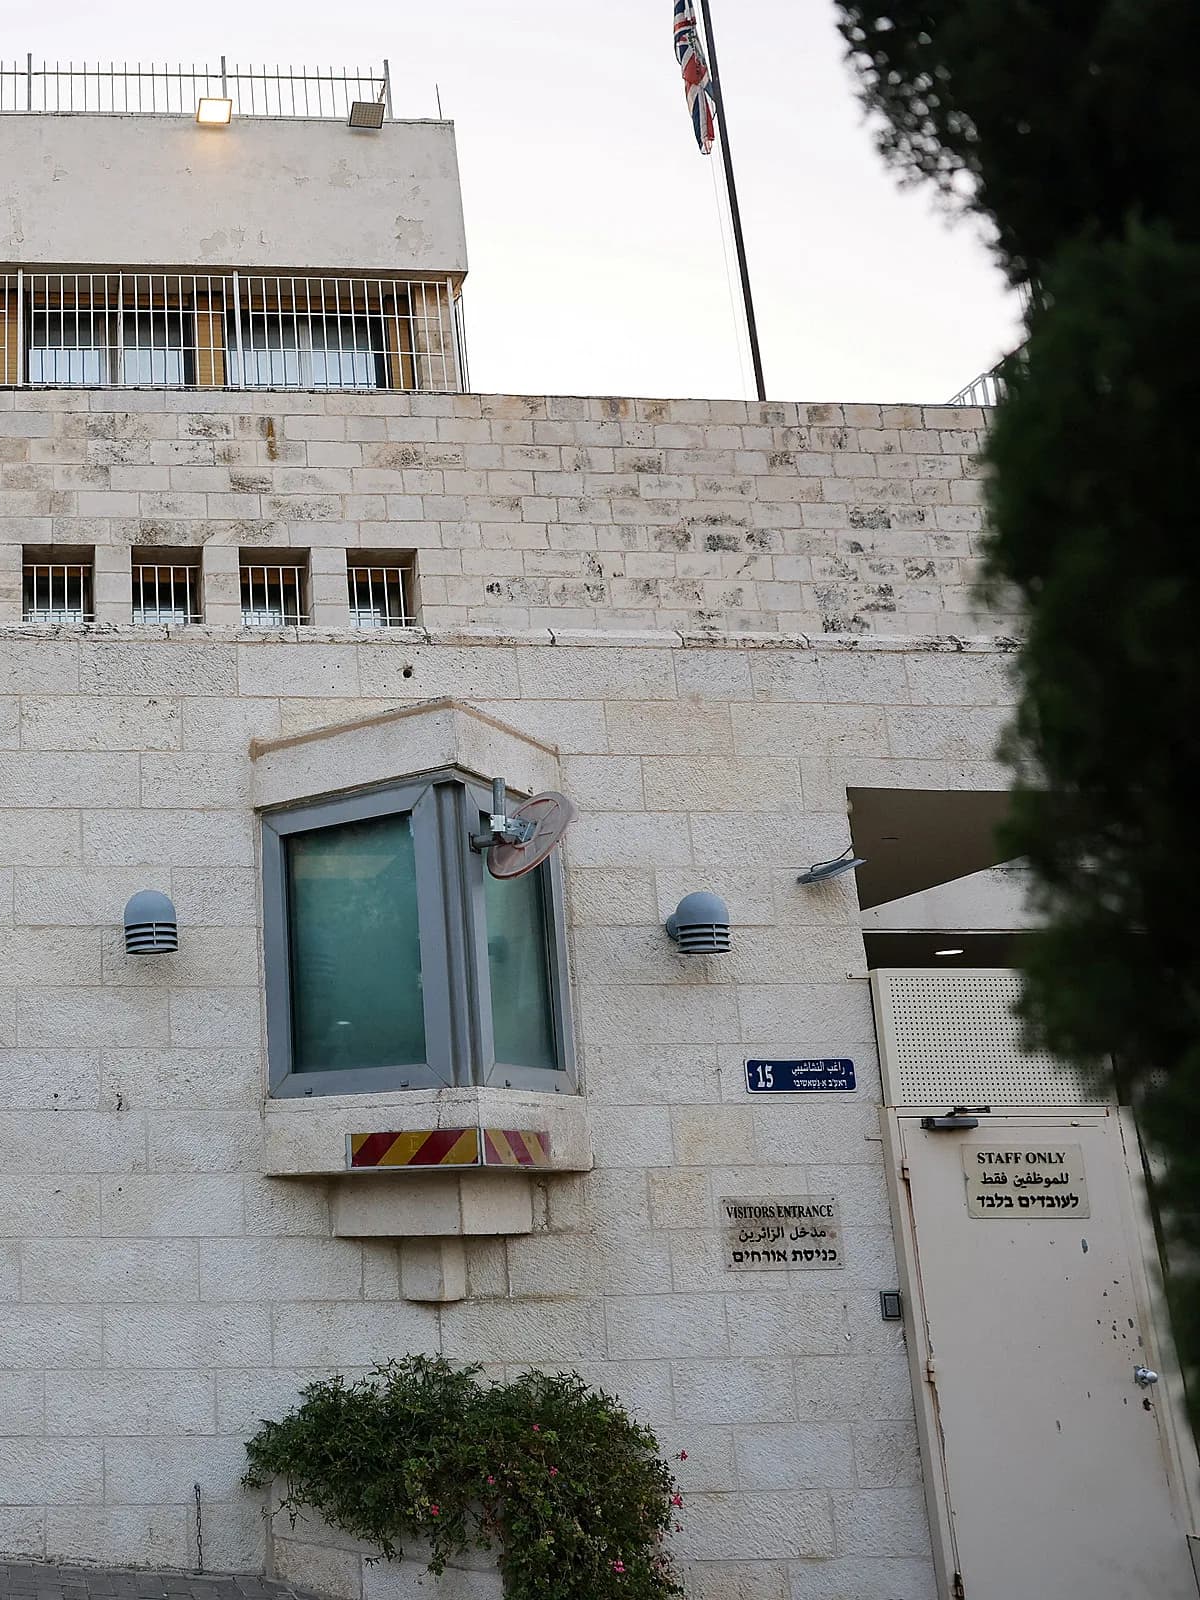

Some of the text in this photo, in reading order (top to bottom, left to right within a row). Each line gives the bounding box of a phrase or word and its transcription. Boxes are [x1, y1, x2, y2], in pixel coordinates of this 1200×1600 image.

[827, 1061, 846, 1075] راغب
[757, 1064, 774, 1088] 15
[977, 1152, 1066, 1164] STAFF ONLY
[980, 1172, 1070, 1188] للموظفين فقط
[976, 1193, 1079, 1208] לעובדים בלבד
[726, 1205, 834, 1219] VISITORS ENTRANCE
[739, 1226, 827, 1242] مدخل الزائرين
[732, 1248, 837, 1263] כניסת אורחים
